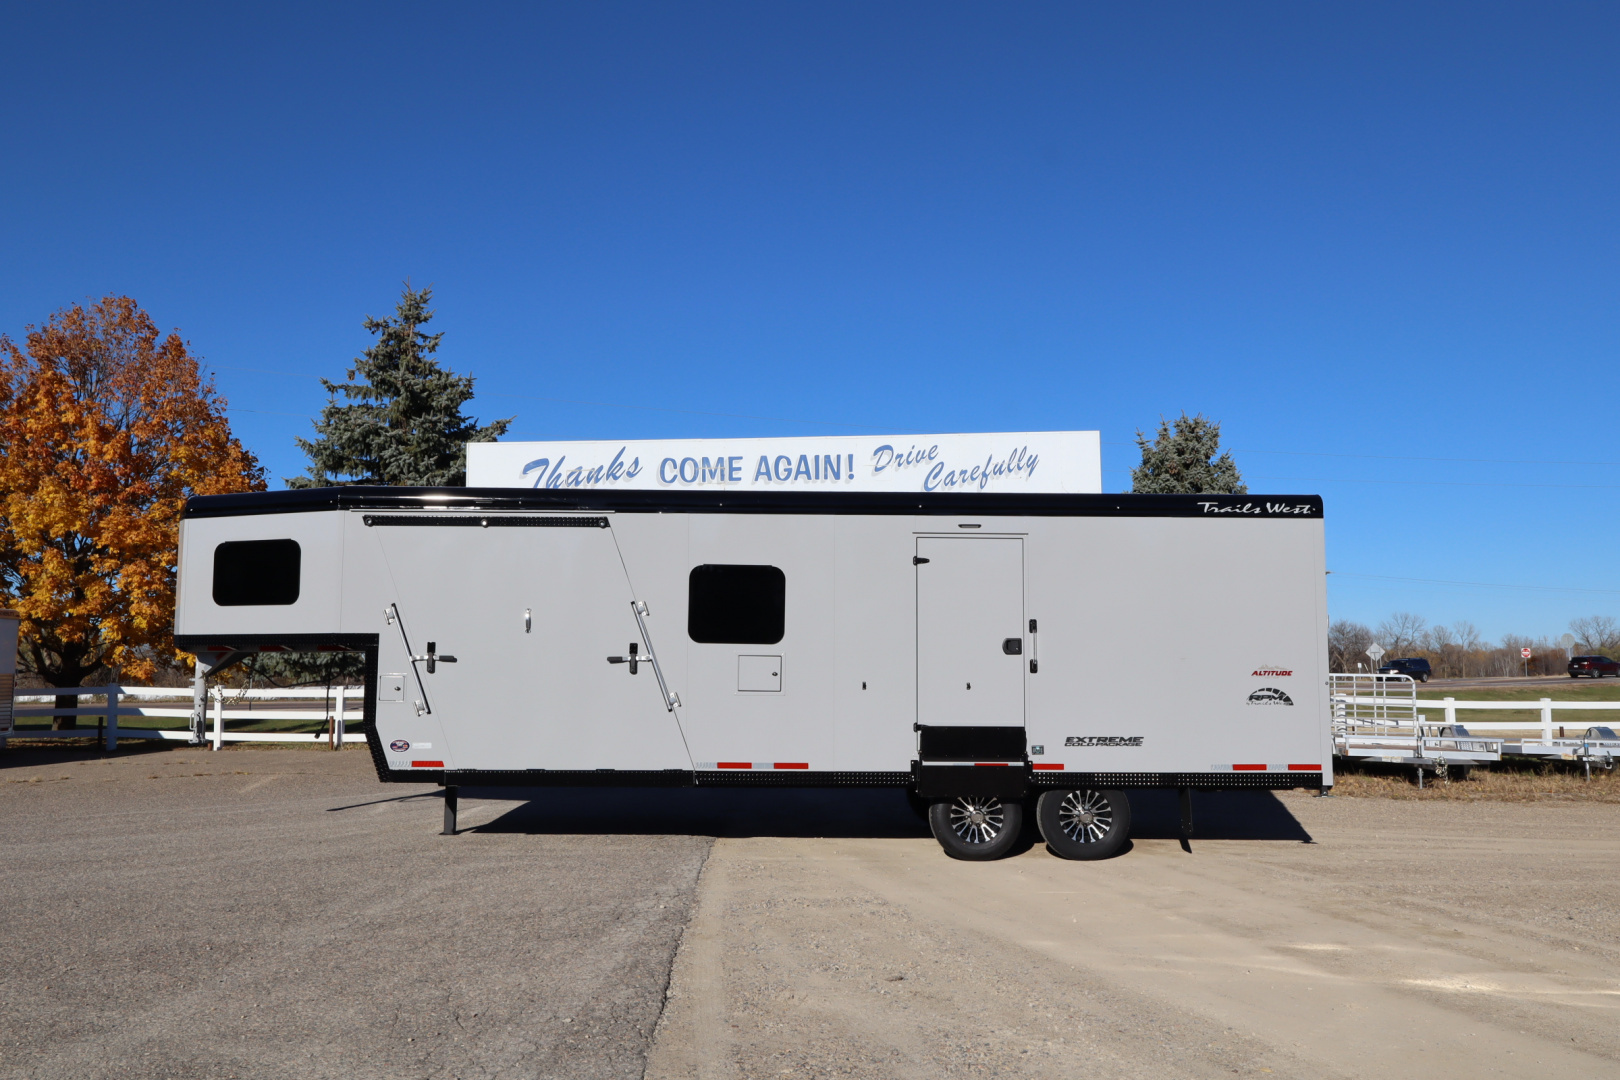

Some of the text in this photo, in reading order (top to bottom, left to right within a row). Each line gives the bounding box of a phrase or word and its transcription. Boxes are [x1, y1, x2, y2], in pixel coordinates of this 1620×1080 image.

[522, 446, 855, 489] Thanks COME AGAIN!
[873, 444, 938, 473] Drive
[923, 445, 1040, 492] Carefully
[1197, 501, 1311, 514] Trails West
